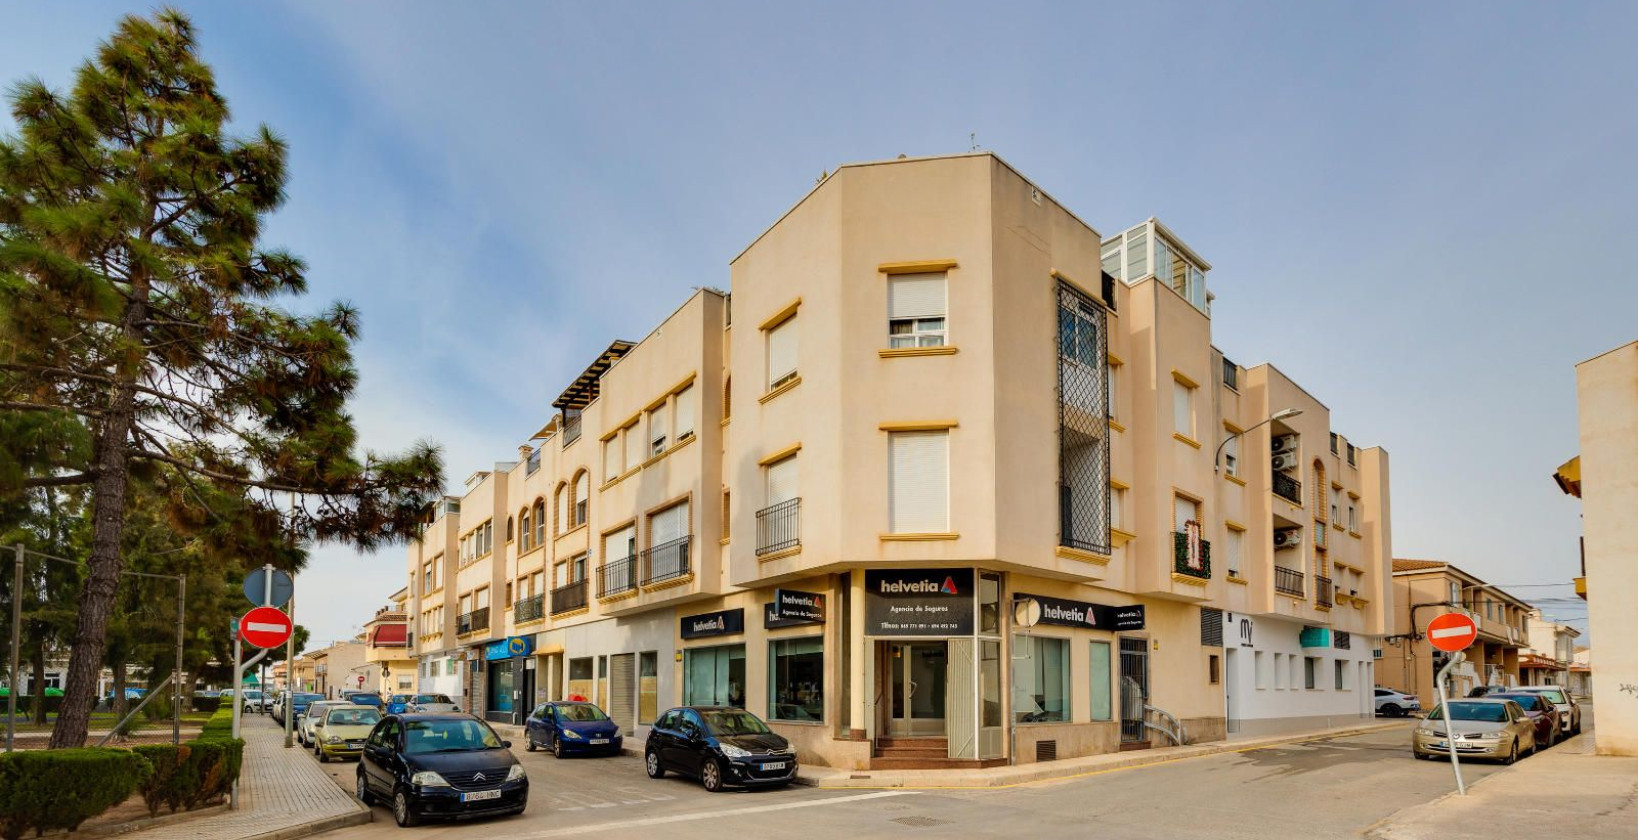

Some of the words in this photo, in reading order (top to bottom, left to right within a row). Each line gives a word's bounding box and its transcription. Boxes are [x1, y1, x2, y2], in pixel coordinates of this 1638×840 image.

[881, 580, 939, 593] helvetia
[782, 595, 812, 606] helvetia
[890, 605, 914, 614] Agencia
[924, 605, 948, 614] Seguros
[1044, 604, 1084, 622] helvetia
[693, 617, 717, 632] helvetia
